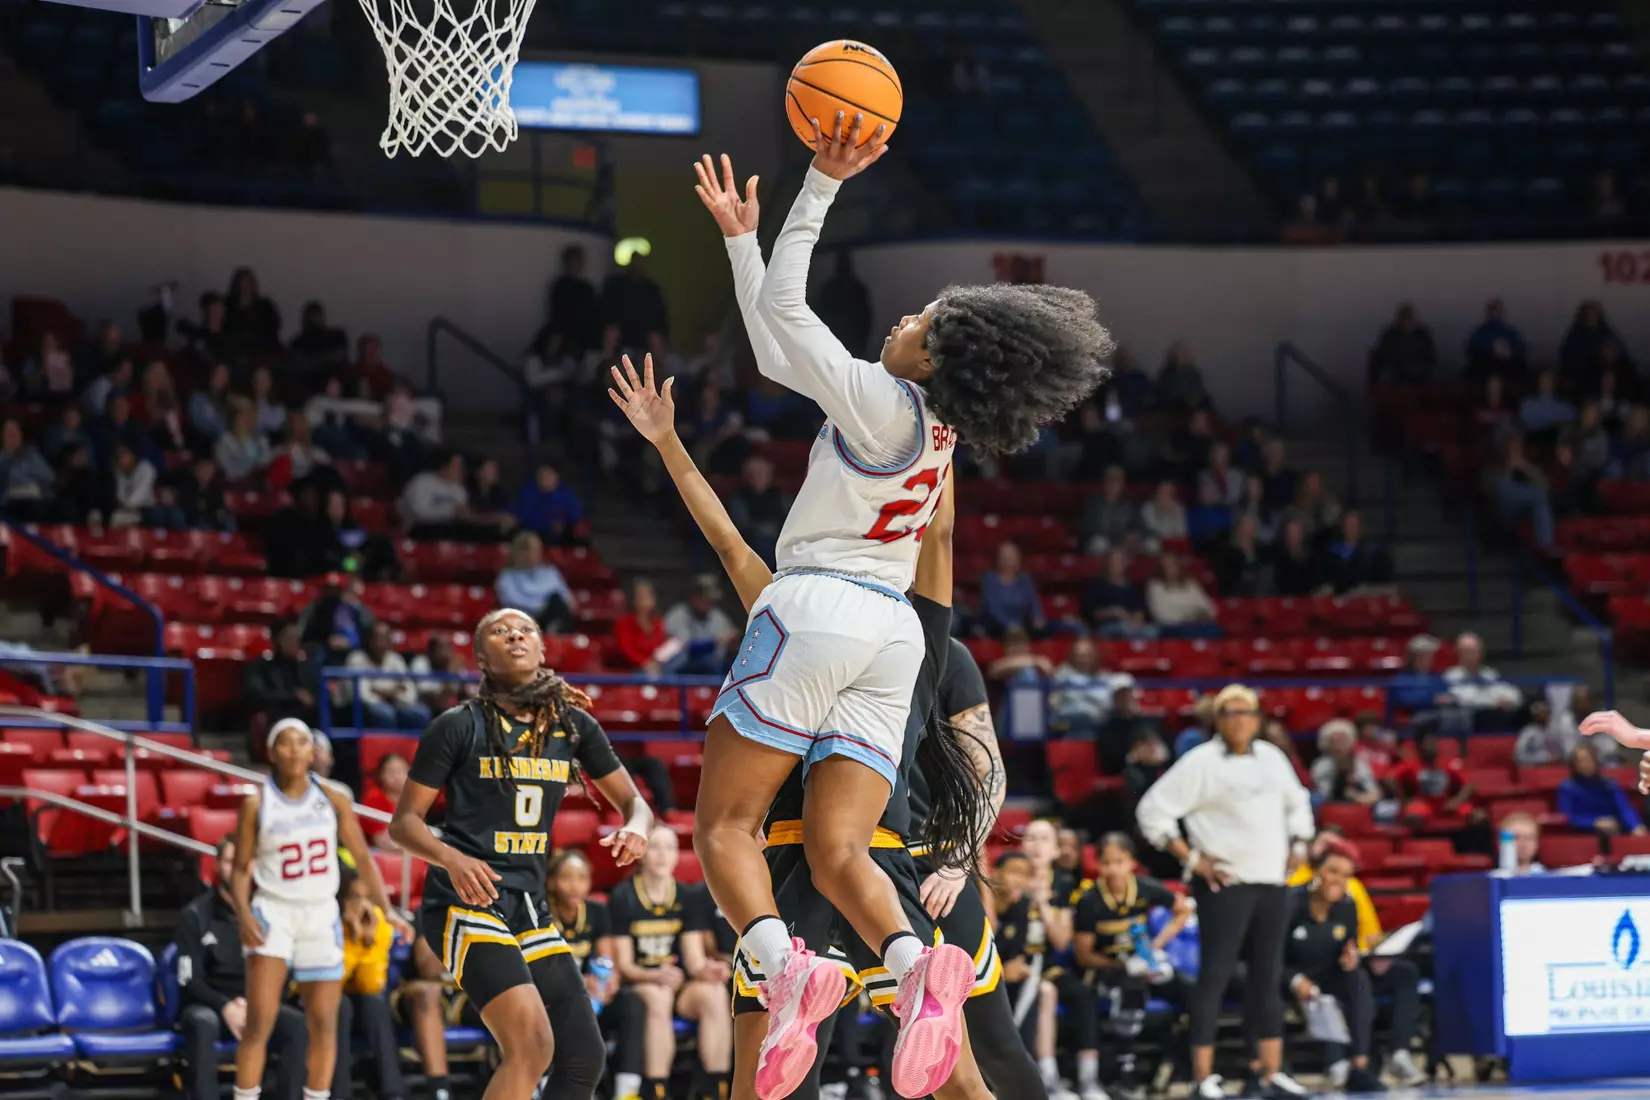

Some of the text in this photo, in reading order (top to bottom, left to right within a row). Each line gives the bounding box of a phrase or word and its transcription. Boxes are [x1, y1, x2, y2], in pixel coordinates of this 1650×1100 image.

[515, 784, 544, 827] 0
[279, 839, 330, 879] 22
[494, 831, 548, 854] STATE
